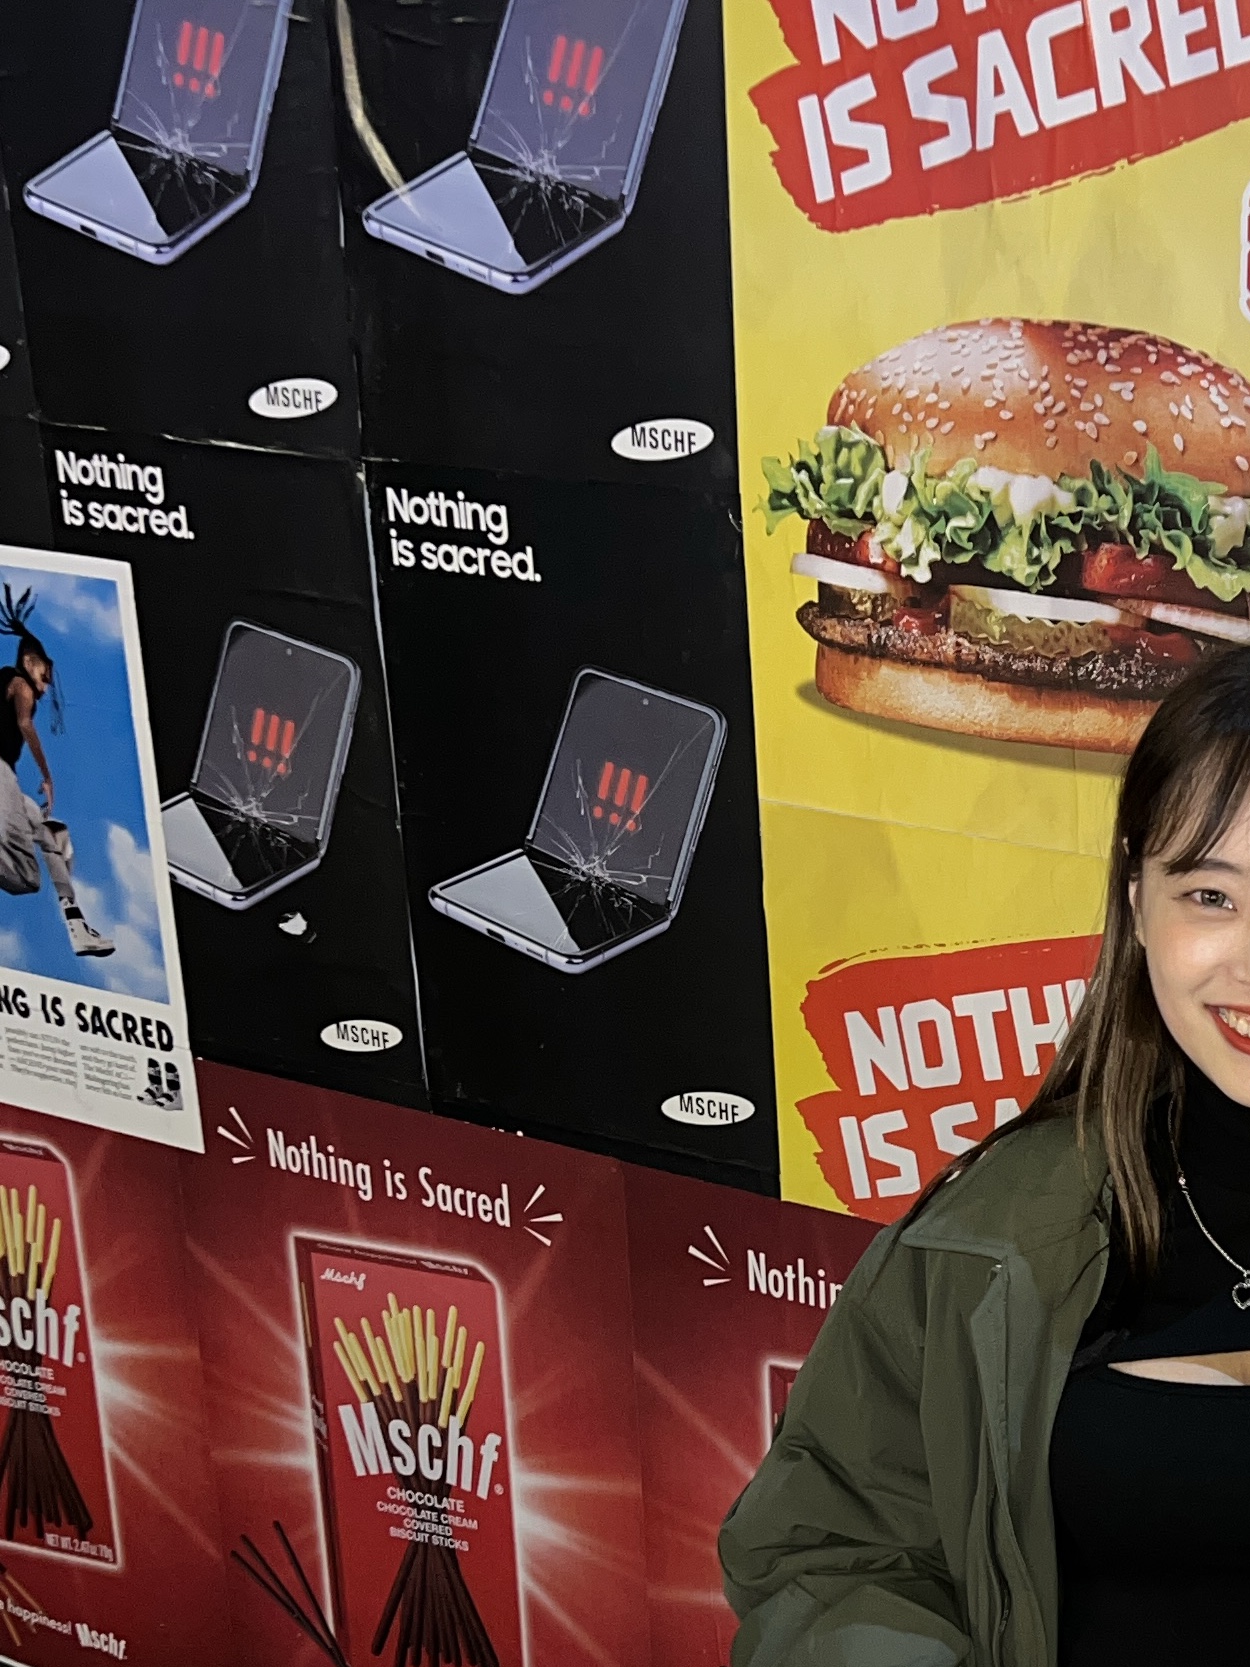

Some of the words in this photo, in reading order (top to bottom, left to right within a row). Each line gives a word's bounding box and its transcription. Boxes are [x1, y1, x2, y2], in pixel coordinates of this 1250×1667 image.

[797, 73, 892, 203] IS
[266, 385, 322, 412] MSCHF
[631, 424, 696, 455] MSCHF
[55, 449, 165, 505] Nothing
[60, 489, 85, 526] is
[87, 501, 195, 540] sacred.
[385, 486, 510, 546] Nothing
[389, 528, 416, 568] is
[420, 541, 542, 583] sacred.
[40, 993, 65, 1027] IS
[75, 1002, 174, 1053] SACRED
[336, 1022, 389, 1049] MSCHF
[680, 1093, 739, 1123] MSCHF
[839, 1109, 921, 1200] IS
[266, 1128, 372, 1201] Nothing
[383, 1159, 407, 1200] is
[418, 1166, 511, 1228] Sacred
[320, 1267, 366, 1291] Mschf
[338, 1401, 502, 1501] Mschf
[376, 1500, 440, 1523] CHOCOLATE
[440, 1513, 478, 1530] CREAM
[386, 1486, 466, 1514] CHOCOLATE
[403, 1518, 453, 1537] COVERED
[431, 1534, 469, 1551] STICKS
